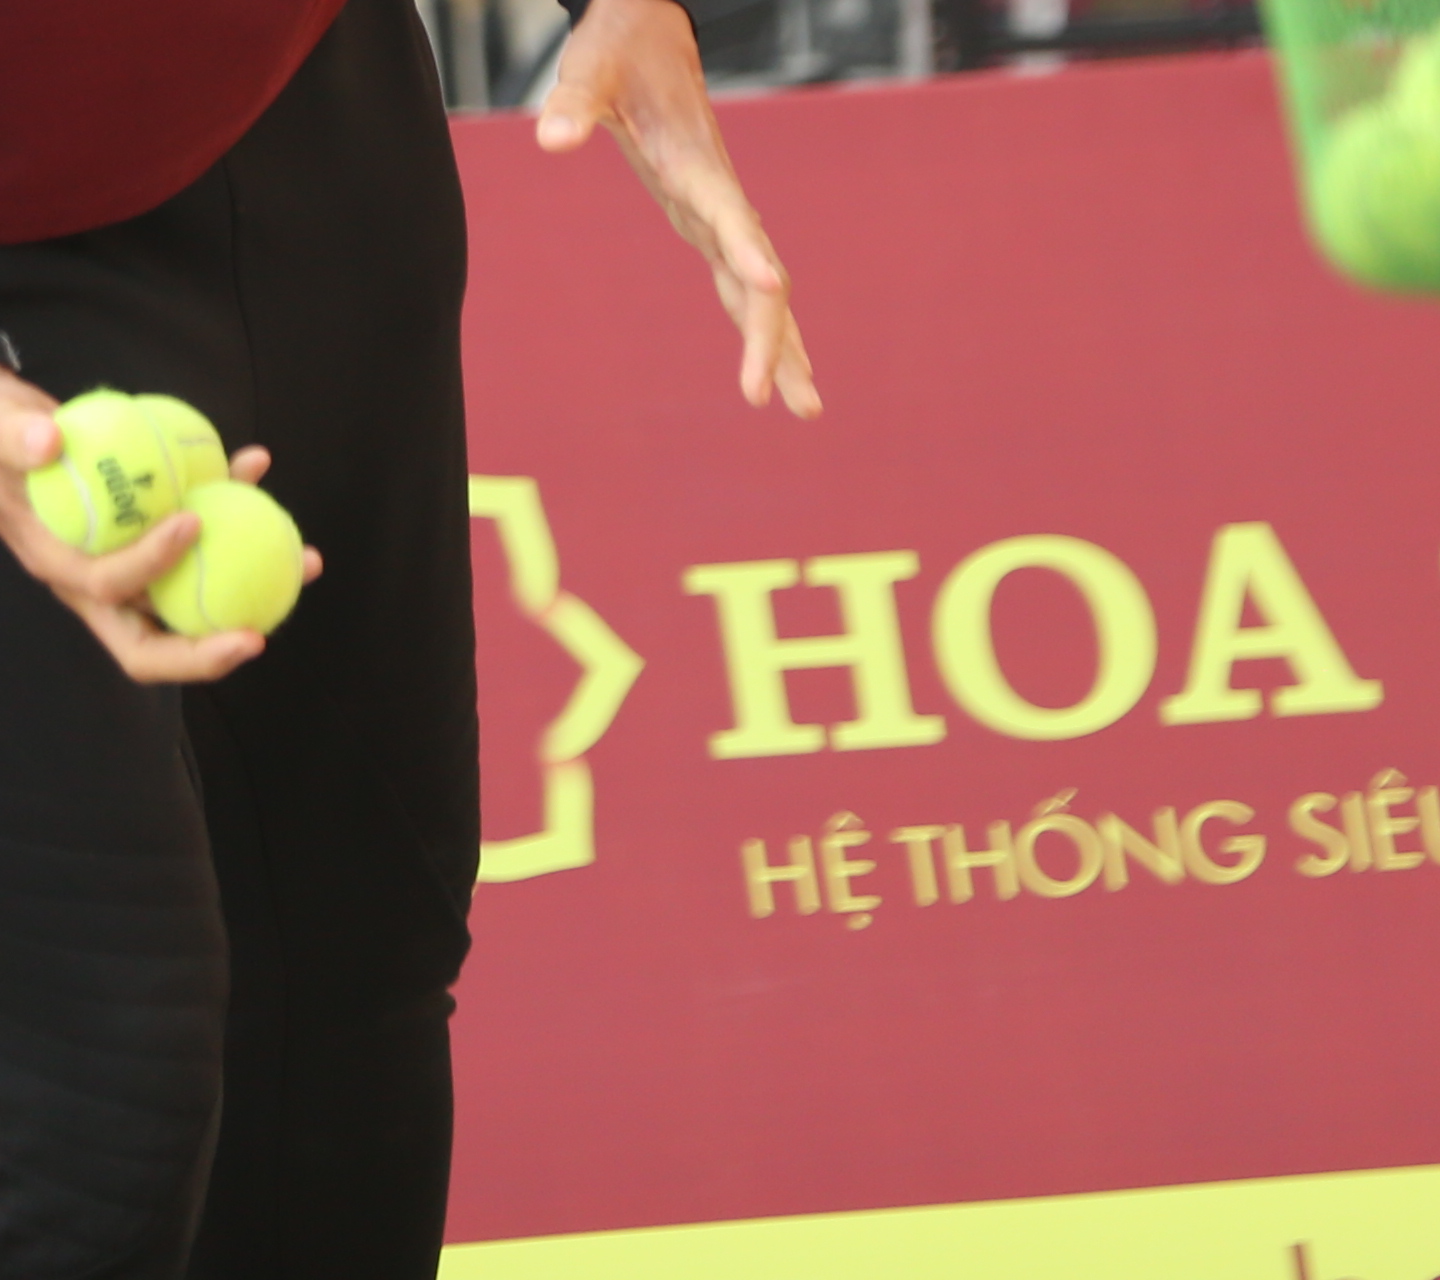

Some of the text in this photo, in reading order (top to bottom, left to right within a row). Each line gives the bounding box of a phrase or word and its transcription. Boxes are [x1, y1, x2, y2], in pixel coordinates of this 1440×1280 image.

[683, 520, 1384, 760] HOA
[742, 813, 881, 927] HỆ
[892, 789, 1267, 902] THỐNG
